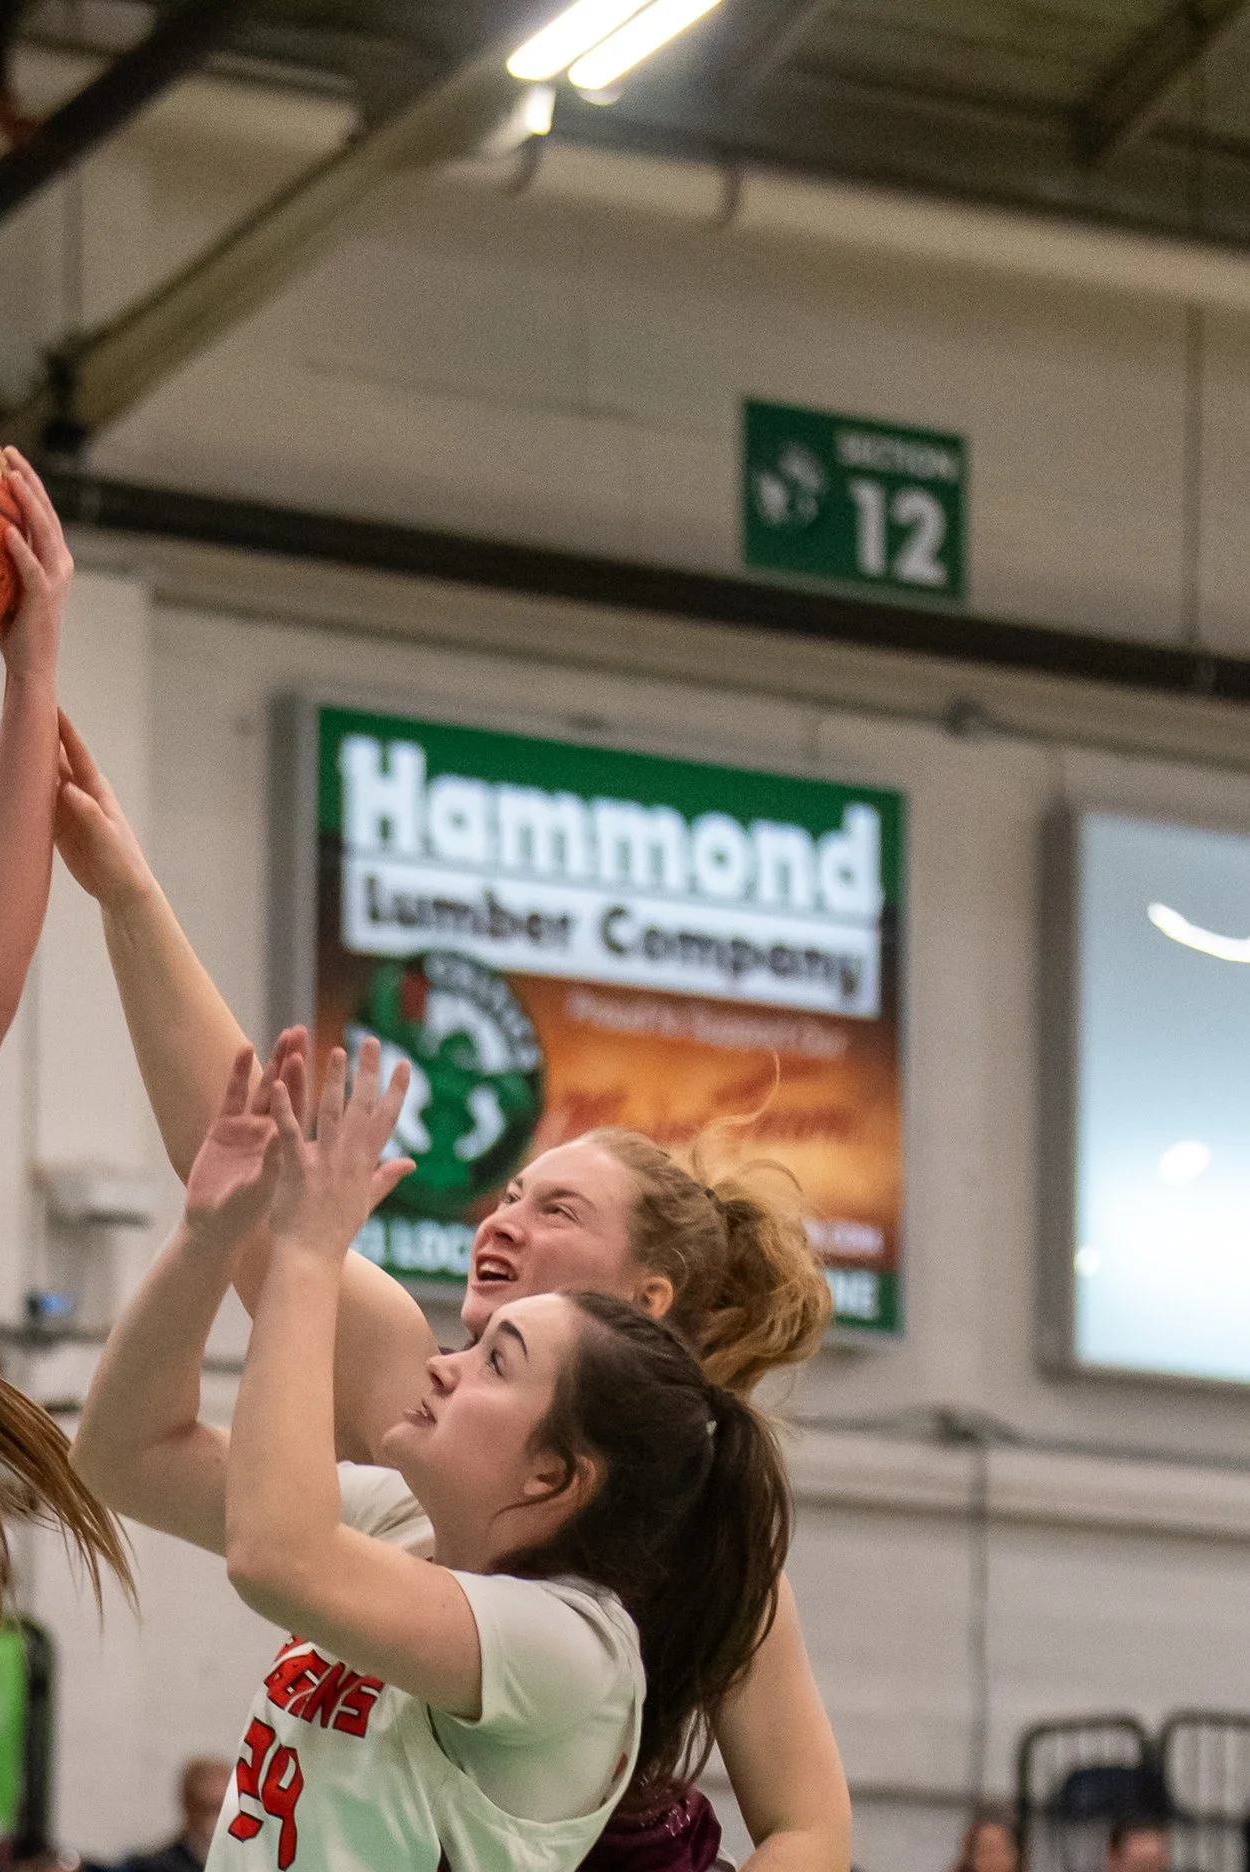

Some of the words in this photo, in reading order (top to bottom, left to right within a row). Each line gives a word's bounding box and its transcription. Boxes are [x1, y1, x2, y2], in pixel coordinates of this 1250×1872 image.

[847, 478, 948, 587] 12
[340, 734, 883, 916] Hammond
[365, 875, 572, 952] Lumber
[599, 905, 862, 997] Company
